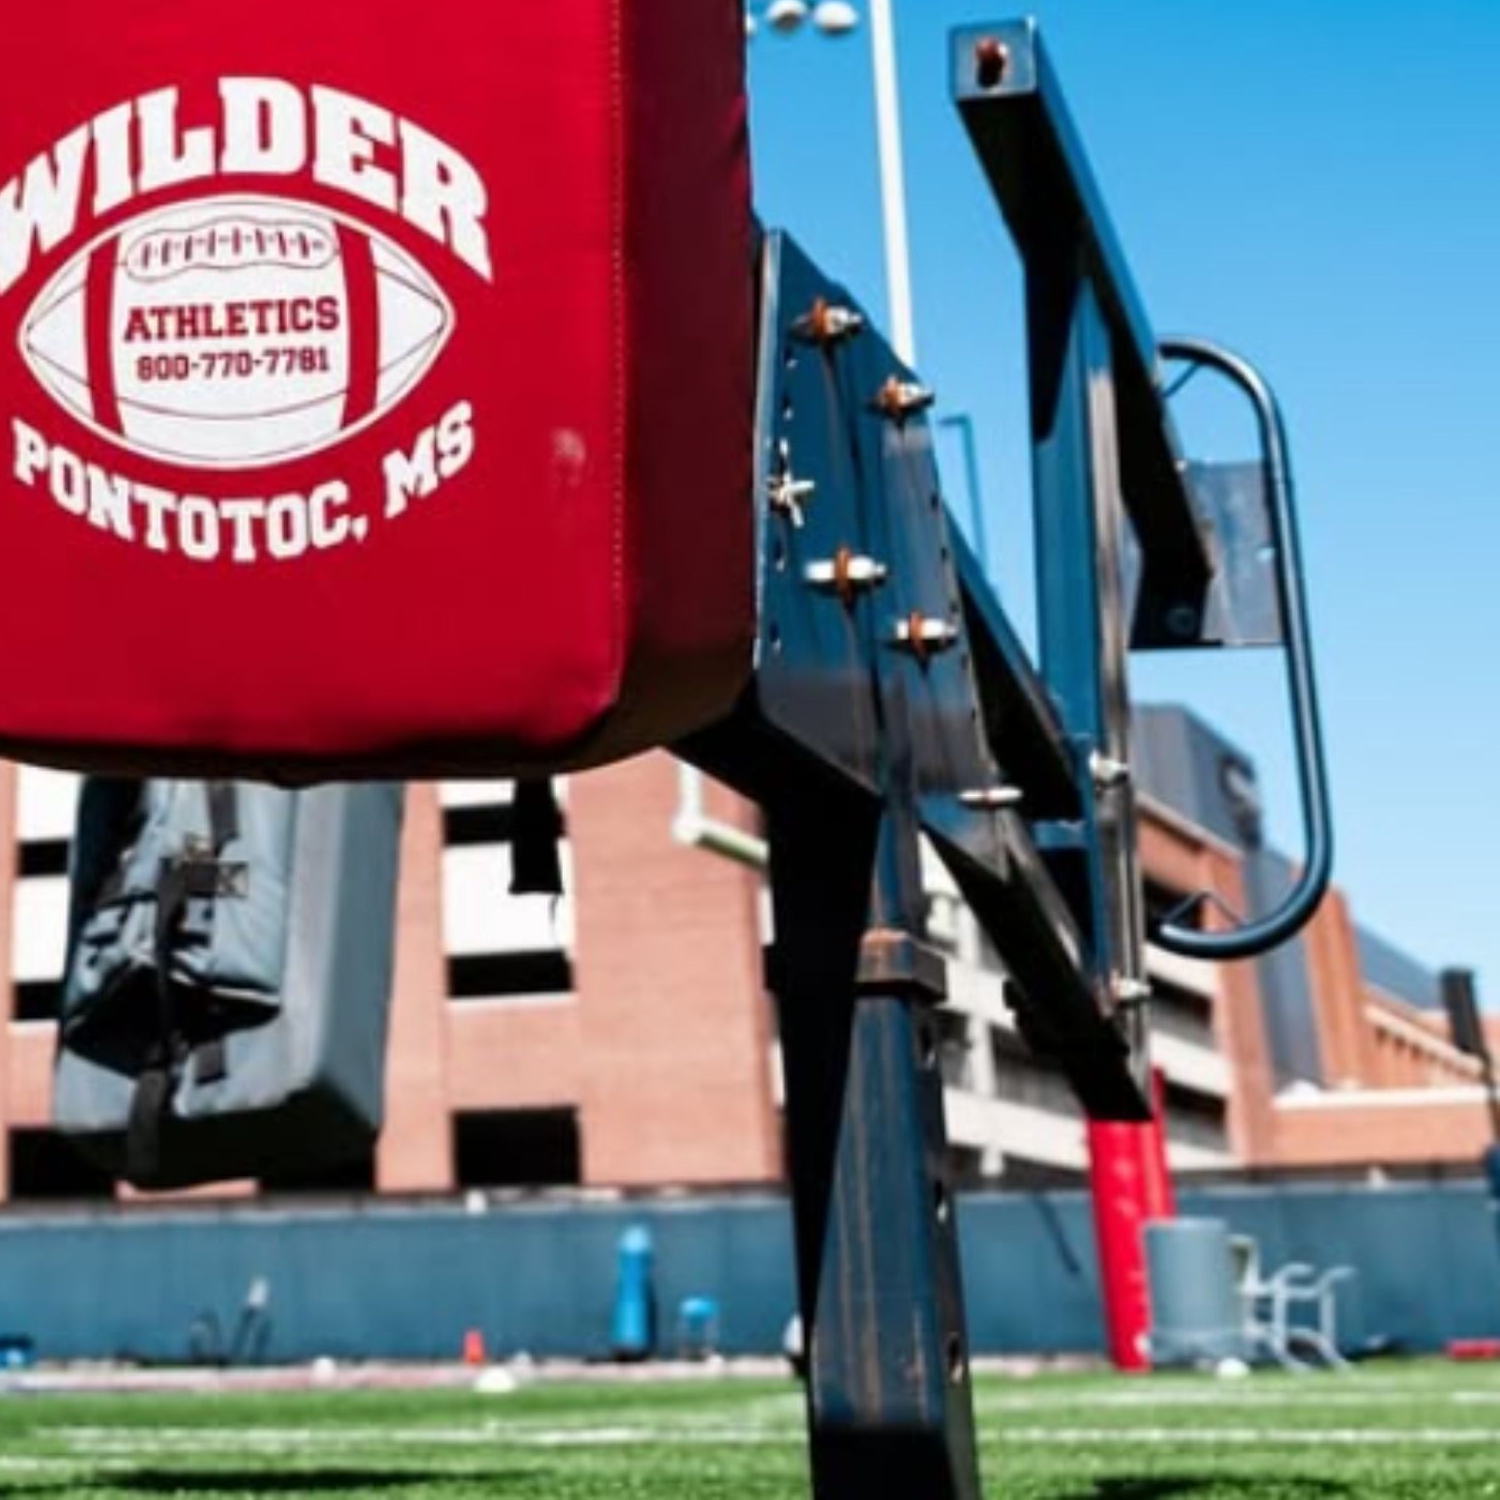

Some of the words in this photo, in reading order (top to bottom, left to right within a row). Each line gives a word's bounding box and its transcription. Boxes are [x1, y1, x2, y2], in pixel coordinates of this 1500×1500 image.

[123, 296, 340, 343] ATHLETICS
[136, 346, 330, 382] 800-770-7781
[11, 416, 368, 562] PONTOTOC,
[382, 400, 475, 519] MS
